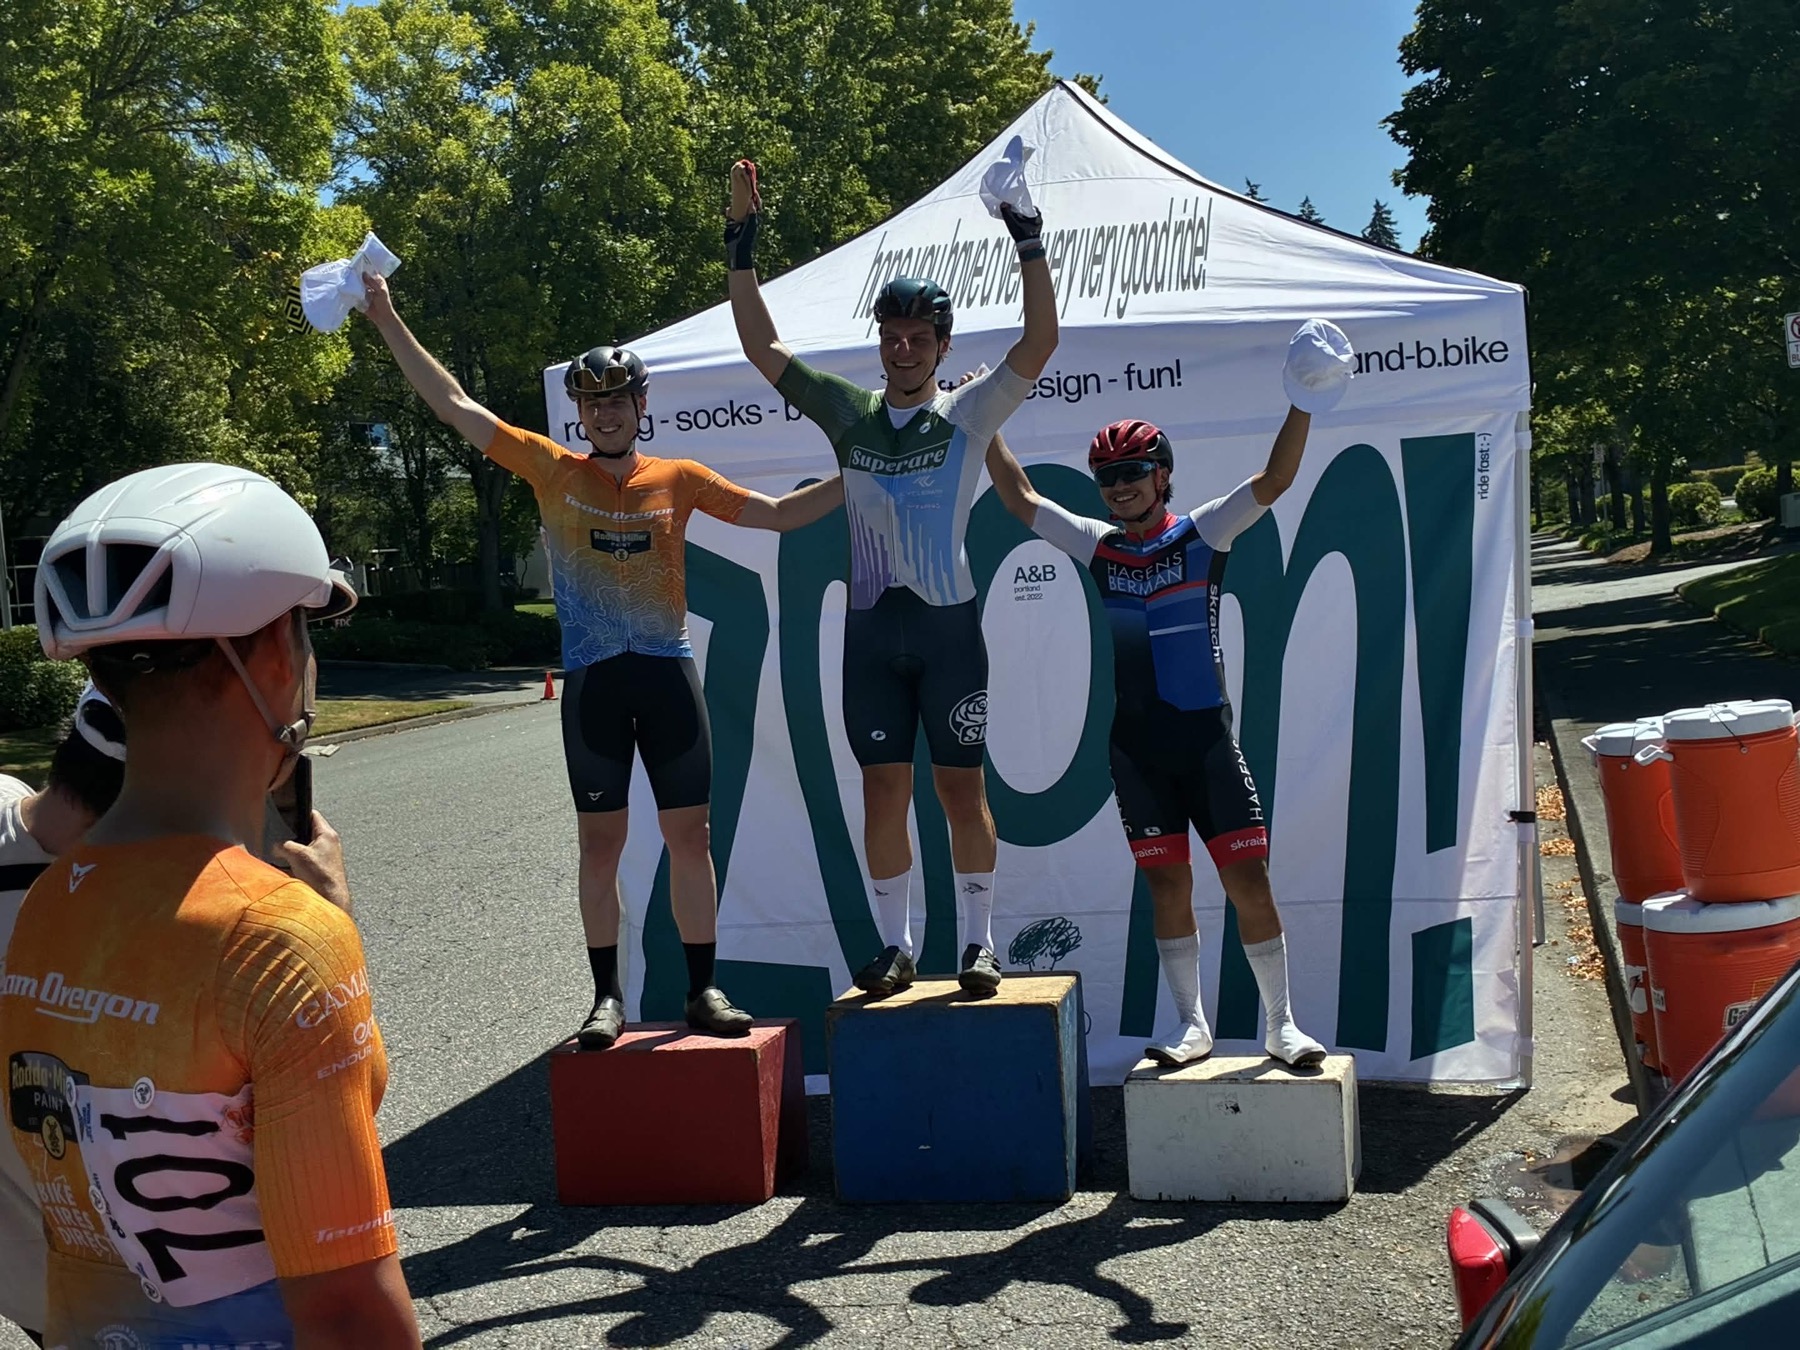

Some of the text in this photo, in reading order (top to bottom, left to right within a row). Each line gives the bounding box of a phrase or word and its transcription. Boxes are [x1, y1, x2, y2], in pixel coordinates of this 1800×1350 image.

[1078, 224, 1126, 318] very
[1116, 197, 1174, 320] good
[1167, 196, 1213, 292] ride!
[1025, 369, 1101, 403] sign
[1123, 358, 1183, 391] fun!
[675, 399, 763, 432] socks
[851, 448, 945, 474] Superare
[1477, 475, 1490, 500] ride
[1013, 564, 1057, 584] A&B
[1107, 551, 1183, 582] HAGENS
[1108, 565, 1183, 597] BERMAN
[1014, 585, 1041, 594] portland
[2, 971, 160, 1024] am Oregon
[296, 966, 371, 1029] CAMA
[12, 1060, 49, 1090] Rodda
[317, 1045, 373, 1080] ENDUR
[34, 1091, 64, 1112] PAINT
[36, 1180, 77, 1207] BIKE
[45, 1204, 95, 1231] TIRES
